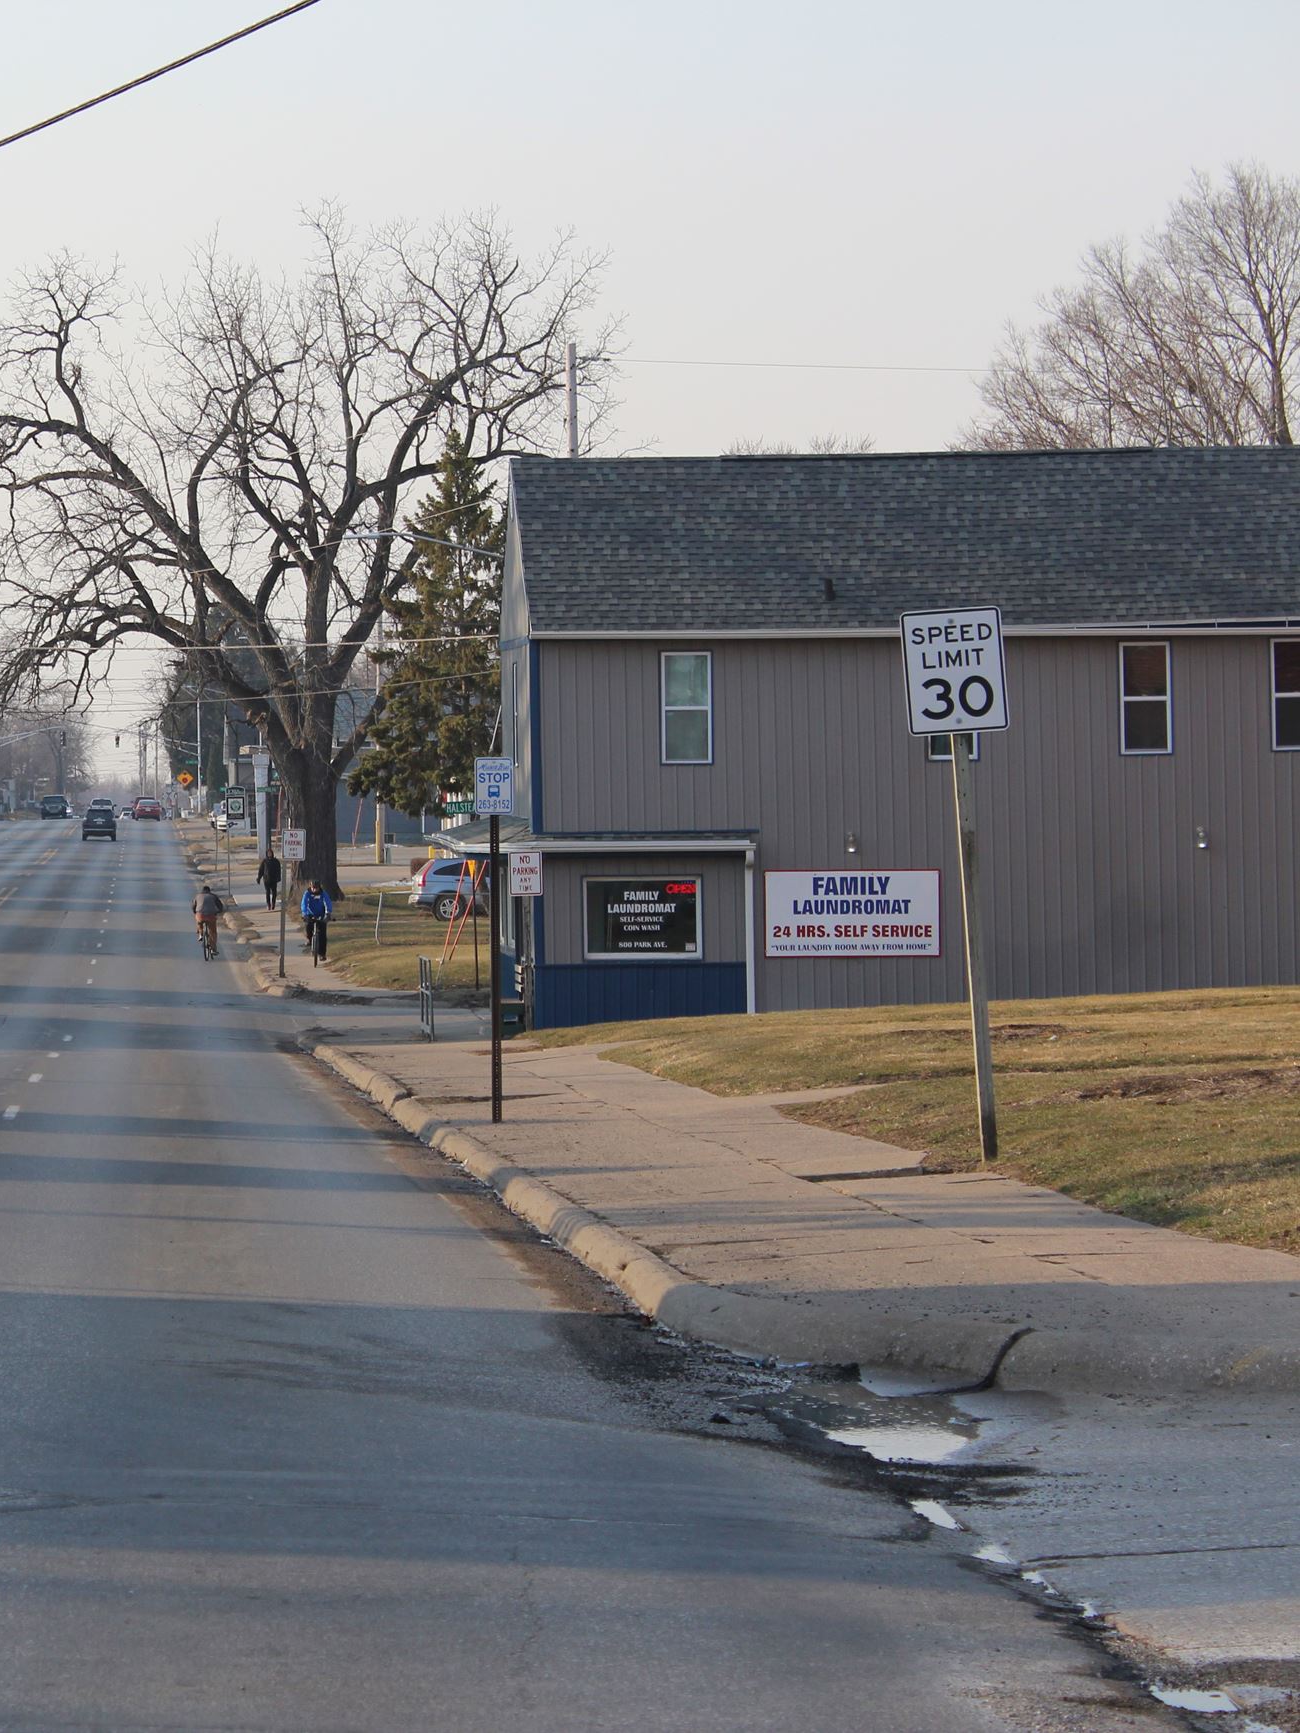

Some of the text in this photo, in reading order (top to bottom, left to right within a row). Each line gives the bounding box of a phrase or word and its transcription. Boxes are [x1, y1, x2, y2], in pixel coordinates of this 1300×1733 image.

[911, 622, 992, 645] SPEED
[922, 648, 984, 670] LIMIT
[921, 675, 994, 720] 30
[478, 773, 510, 783] STOP
[478, 800, 510, 809] 263-8152
[519, 855, 531, 864] NO
[512, 867, 538, 875] PARKING
[665, 883, 697, 894] OPEN
[812, 876, 890, 896] FAMILY
[623, 891, 659, 901] FAMILY
[607, 903, 676, 913] LAUNDROMAT
[793, 899, 911, 915] LAUNDROMAT
[773, 924, 932, 938] 24 HRS. SELF SERVICE
[798, 944, 832, 952] LAUNDRY
[860, 944, 880, 952] AWAY
[882, 943, 904, 951] FROM
